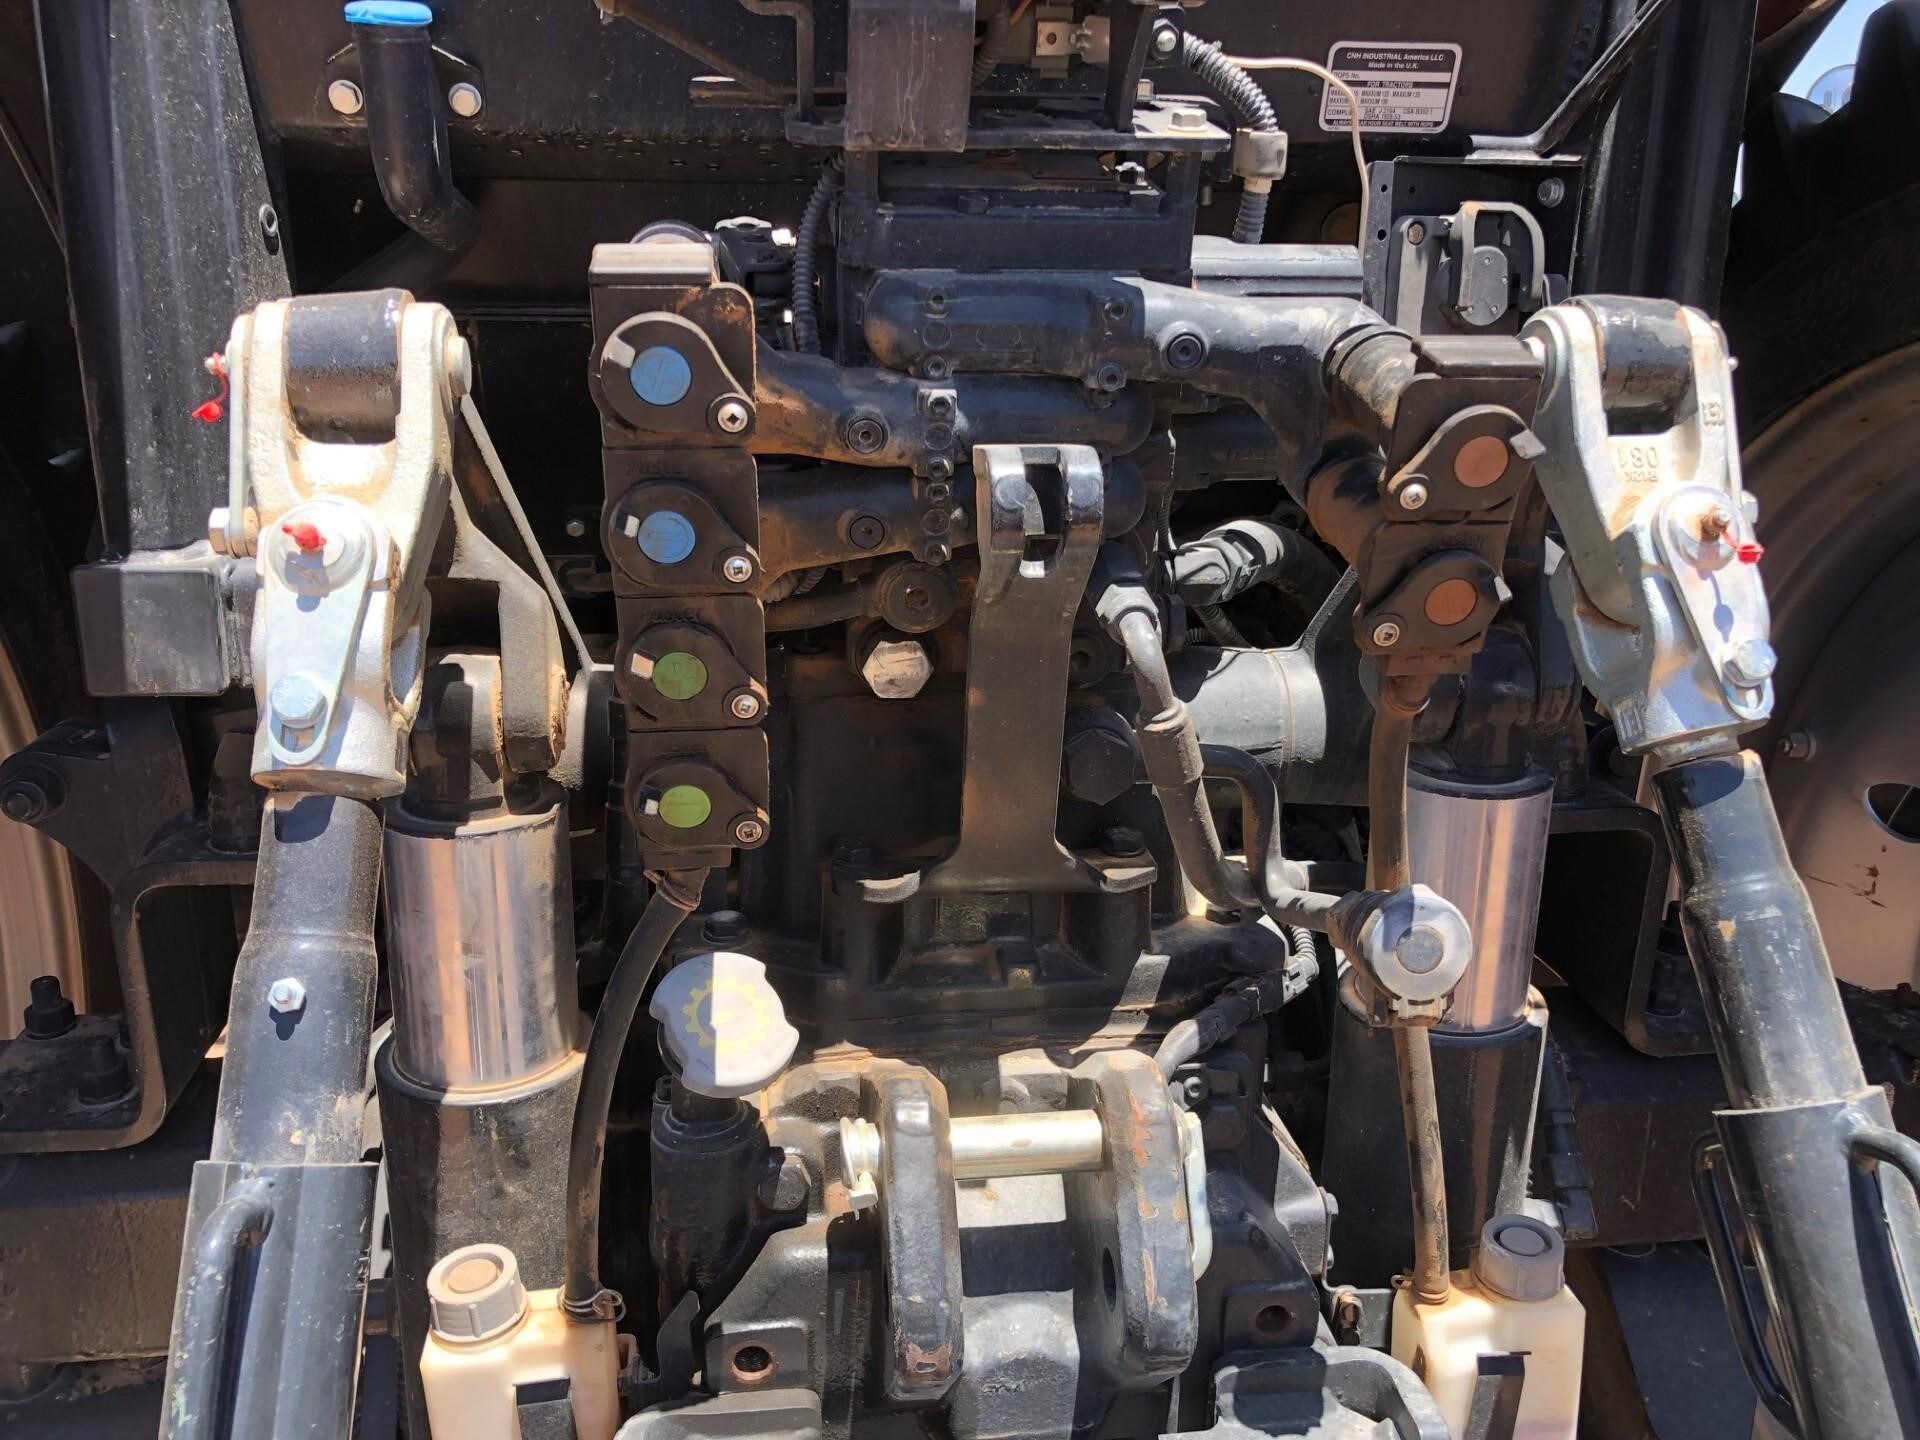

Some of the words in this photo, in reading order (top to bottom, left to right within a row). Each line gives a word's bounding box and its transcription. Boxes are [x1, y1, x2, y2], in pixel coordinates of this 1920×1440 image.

[1346, 52, 1361, 60] CNH
[1362, 52, 1402, 60] INDUSTRIAL
[1403, 53, 1429, 61] America
[1368, 61, 1386, 69] Made
[1405, 62, 1419, 70] U.K.
[1351, 72, 1361, 80] No.
[1382, 81, 1414, 89] TRACTORS
